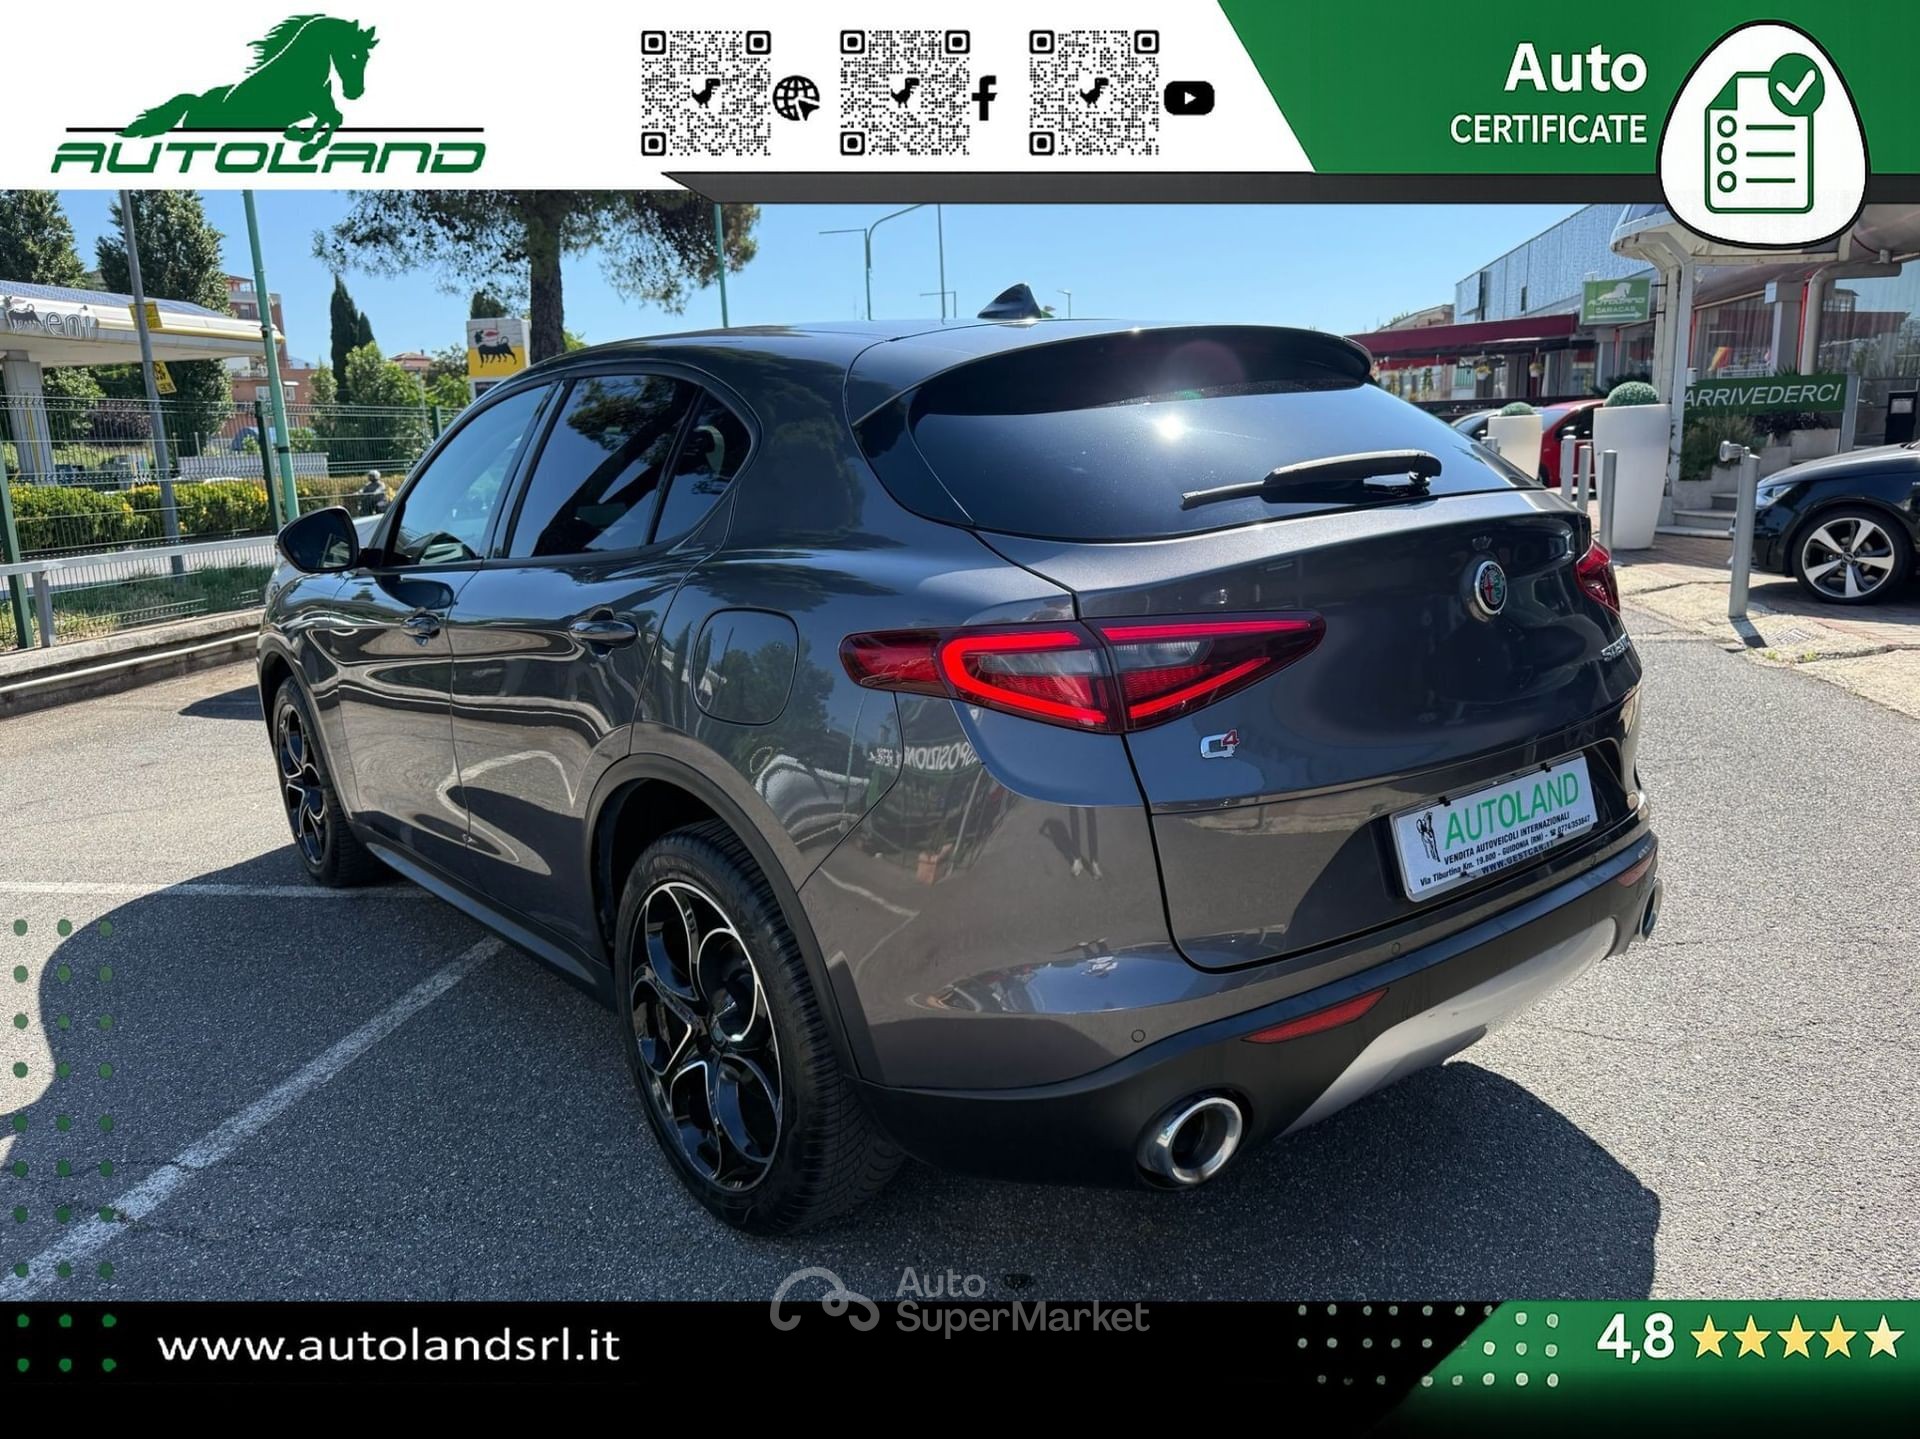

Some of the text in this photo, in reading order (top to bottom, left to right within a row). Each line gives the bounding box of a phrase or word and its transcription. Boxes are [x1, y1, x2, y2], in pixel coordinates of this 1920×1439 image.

[1684, 383, 1842, 408] ARRIVEDERCI
[1445, 772, 1579, 850] AUTOLAND
[1420, 876, 1432, 887] Via
[1433, 866, 1462, 882] Tiburtina
[1502, 839, 1530, 855] GUIDONIA
[1443, 811, 1570, 865] VENDITA AUTOVEICOLI INTERNAZIONALI
